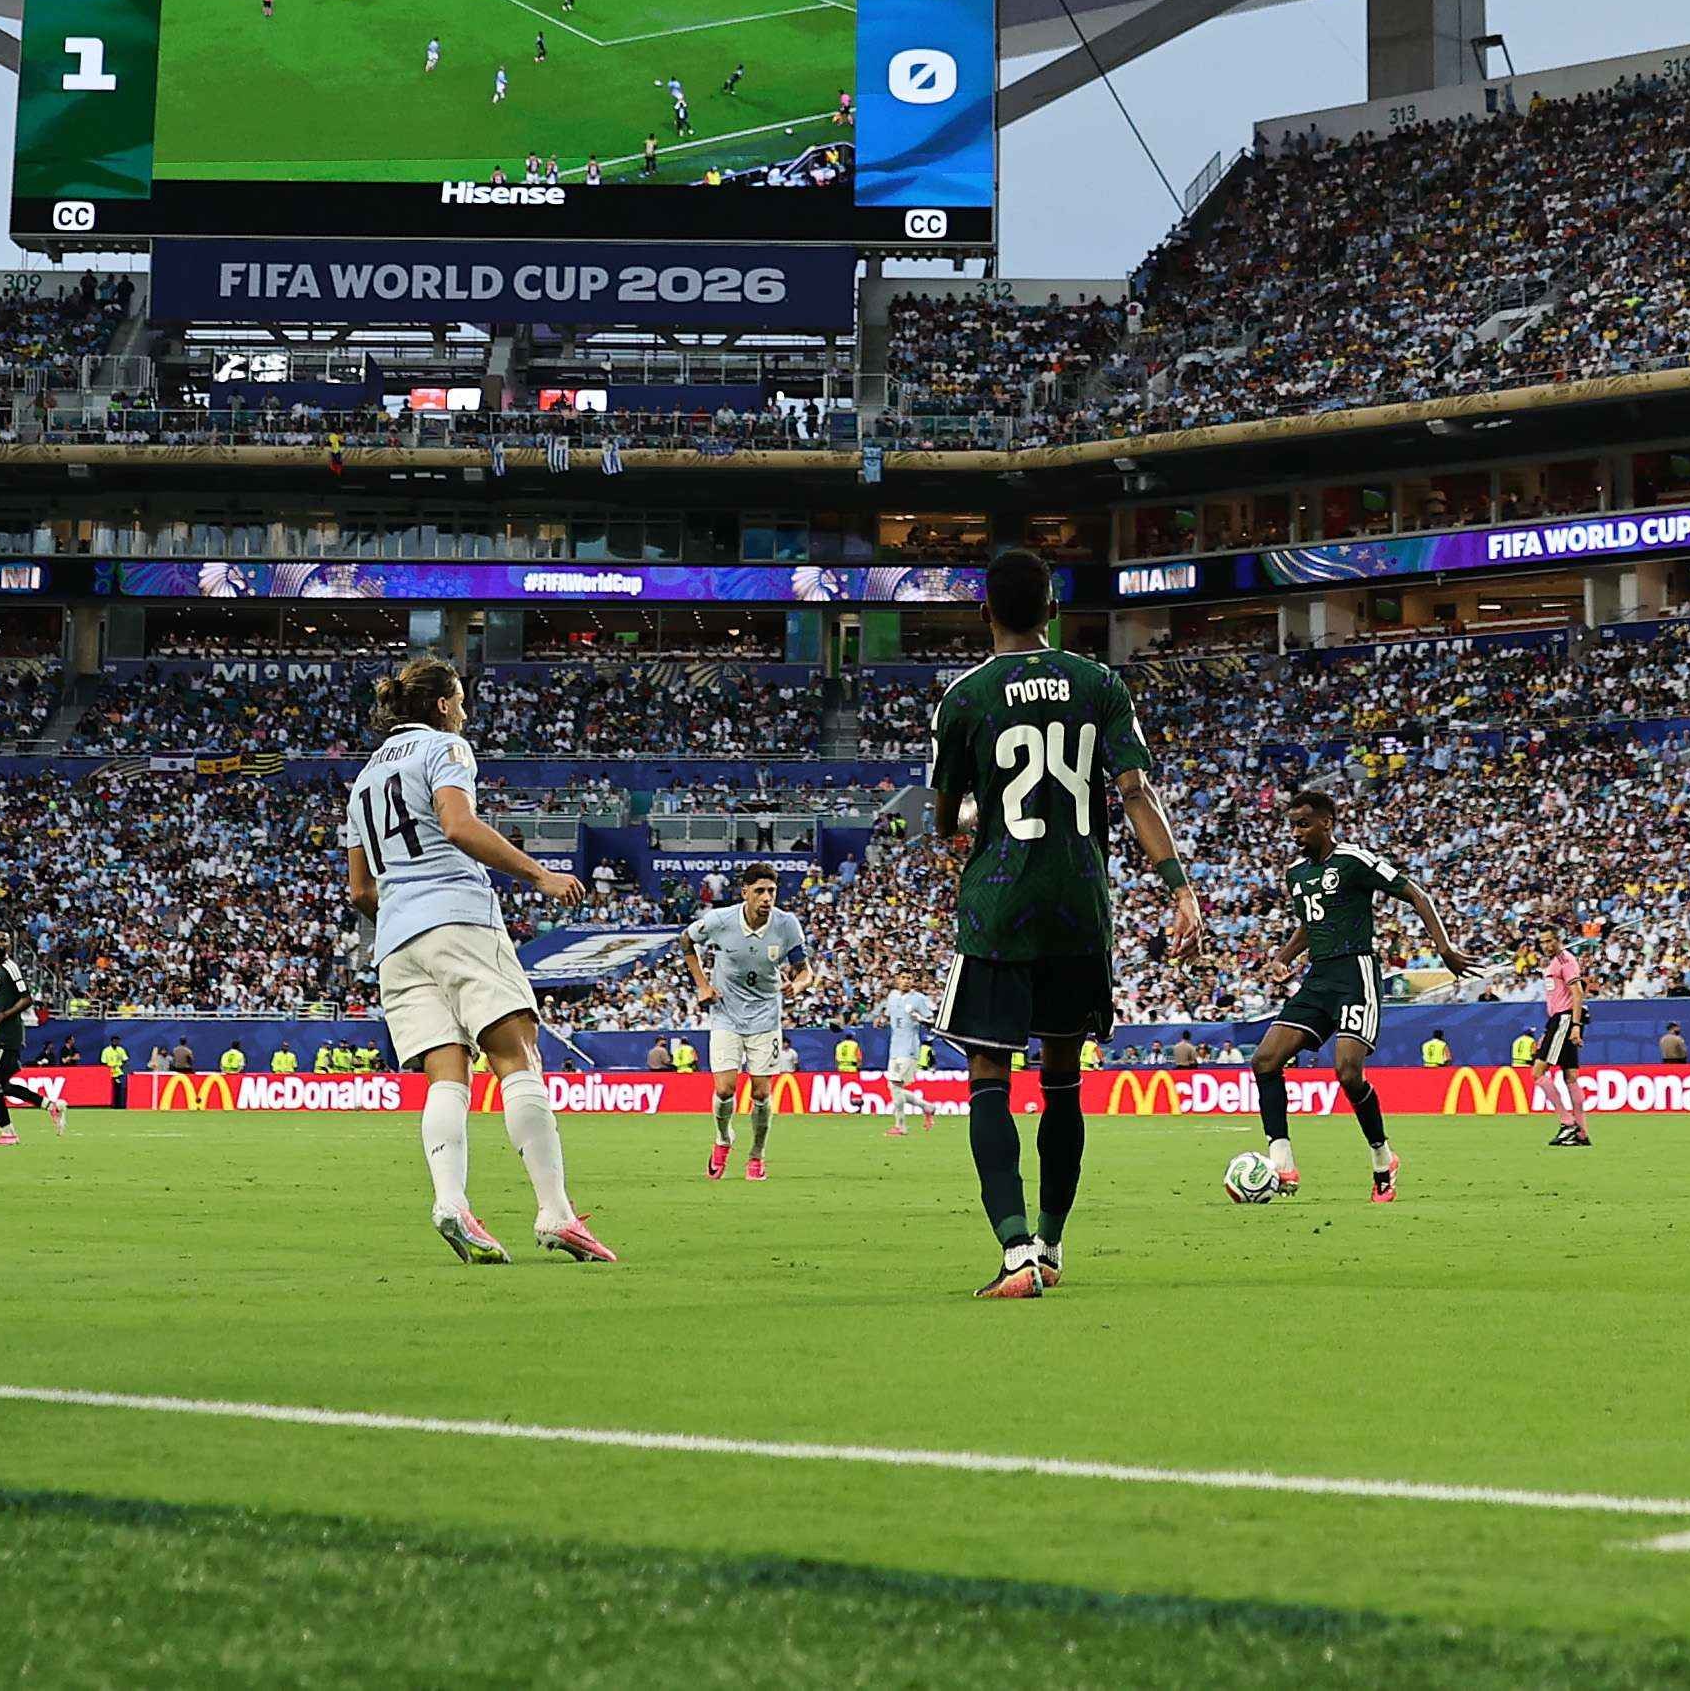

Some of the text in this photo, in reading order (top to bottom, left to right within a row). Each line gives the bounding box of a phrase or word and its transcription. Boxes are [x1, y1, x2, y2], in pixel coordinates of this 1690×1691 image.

[62, 37, 116, 91] 1
[888, 49, 957, 104] 0
[1389, 105, 1417, 124] 313
[441, 181, 565, 205] Hisense
[57, 205, 92, 227] CC
[909, 214, 942, 235] CC
[3, 274, 42, 293] 309
[218, 263, 786, 303] FIFA WORLD CUP 2026
[1488, 532, 1543, 560] FIFA
[1543, 521, 1639, 554] WORLD
[523, 571, 643, 597] #FIFAWorldCup
[1119, 565, 1197, 594] MIAMI
[1005, 677, 1070, 708] MOTEB
[995, 722, 1097, 842] 24
[359, 772, 424, 875] 14
[538, 859, 573, 871] 026
[652, 859, 682, 872] FIFA
[1303, 893, 1325, 922] 15
[746, 970, 758, 987] 8
[1340, 1005, 1364, 1031] 15
[772, 1037, 780, 1060] 8
[238, 1074, 400, 1112] McDonald's
[547, 1073, 663, 1113] Delivery
